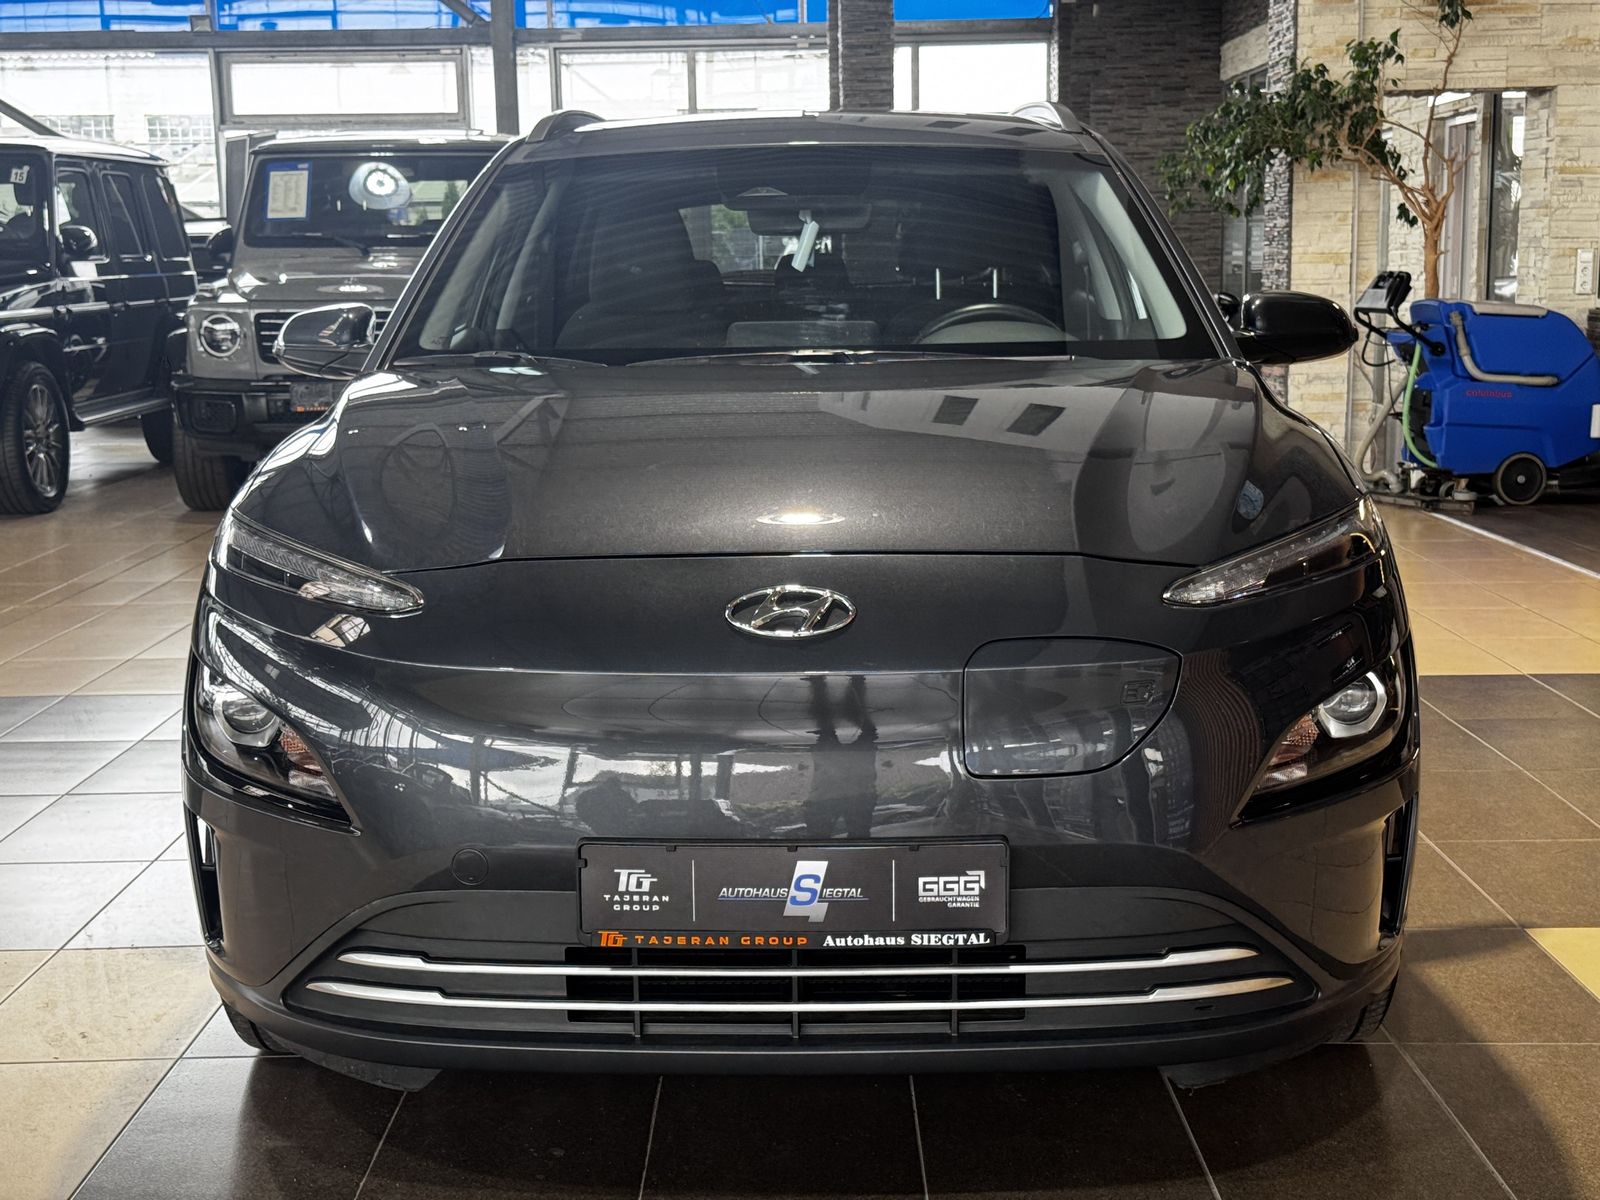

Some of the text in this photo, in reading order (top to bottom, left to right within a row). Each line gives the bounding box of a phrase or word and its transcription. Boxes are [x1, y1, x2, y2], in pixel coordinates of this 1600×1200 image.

[14, 171, 24, 181] 15
[918, 876, 980, 897] GGG
[718, 887, 788, 898] AUTOHAUS
[603, 894, 670, 902] TAJERAN
[635, 935, 729, 945] TAJERAN
[741, 936, 808, 945] GROUP
[822, 932, 990, 947] Autohaus SIEGTAL
